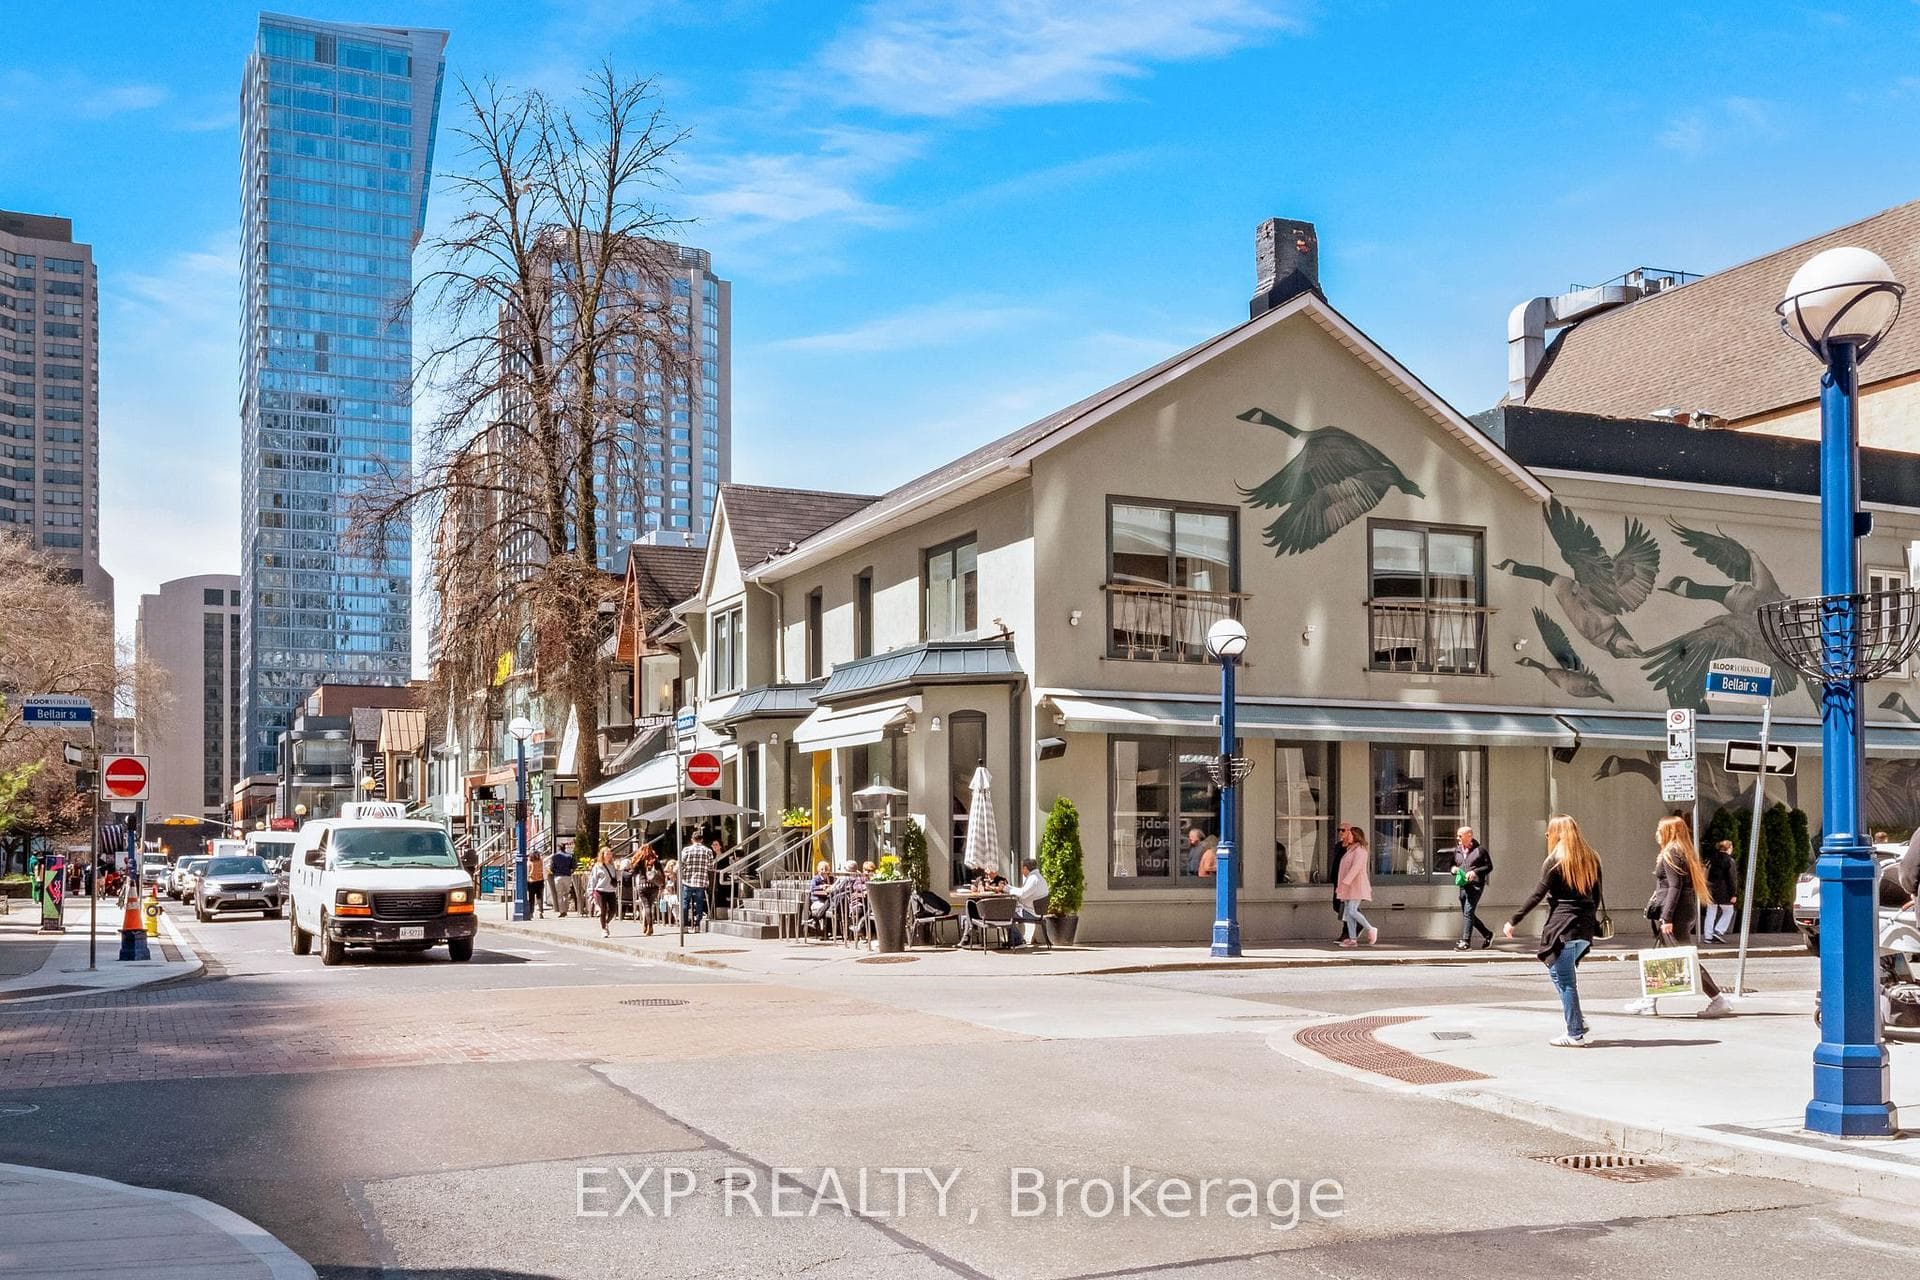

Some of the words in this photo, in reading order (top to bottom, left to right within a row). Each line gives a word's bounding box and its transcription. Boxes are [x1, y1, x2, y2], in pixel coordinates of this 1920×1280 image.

[1722, 677, 1750, 692] Bellair
[1750, 682, 1758, 693] St
[37, 709, 67, 719] Bellair
[69, 711, 77, 719] St
